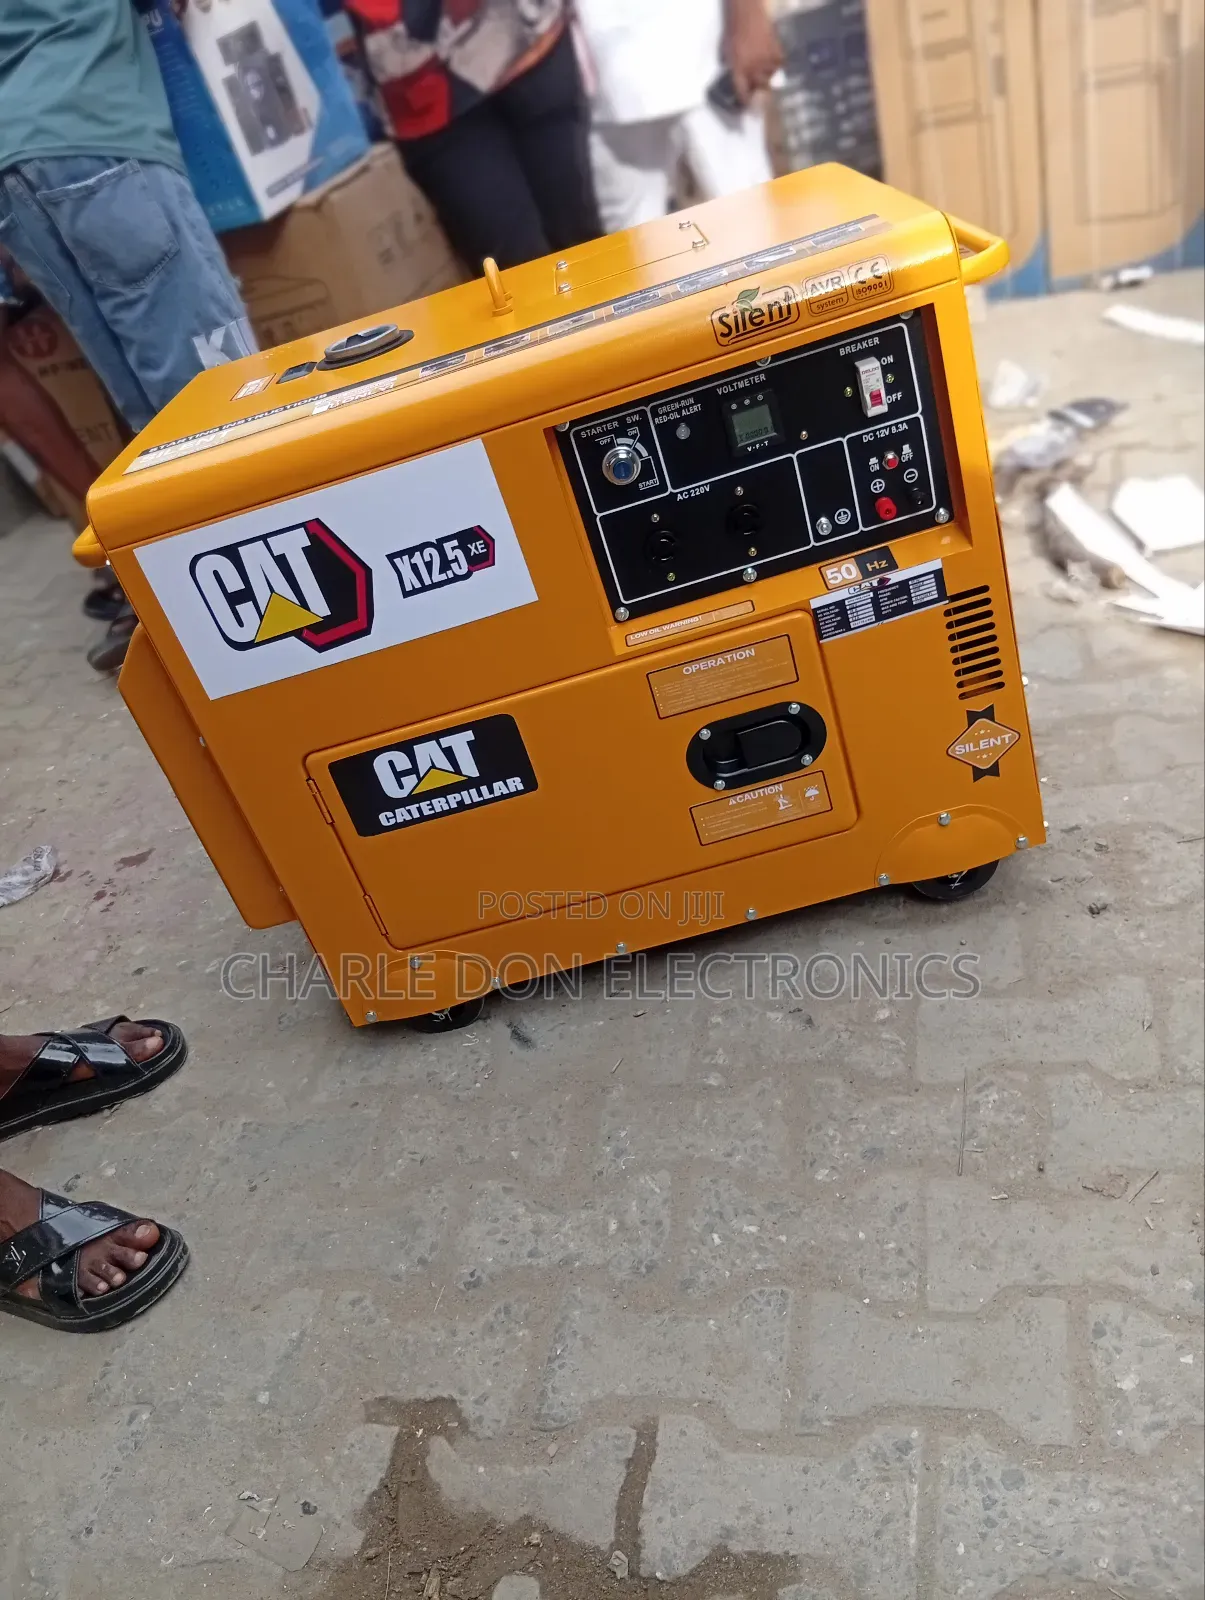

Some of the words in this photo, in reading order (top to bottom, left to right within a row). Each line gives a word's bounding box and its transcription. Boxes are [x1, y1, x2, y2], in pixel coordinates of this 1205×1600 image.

[809, 275, 843, 295] AVR
[718, 290, 792, 338] Silent
[816, 296, 844, 311] system
[839, 336, 880, 356] BREAKER
[881, 354, 894, 366] ON
[716, 373, 766, 396] VOLTMETER
[657, 397, 695, 415] GREEN-RUN
[886, 391, 903, 404] OFF
[148, 427, 219, 453] STARTING
[222, 393, 328, 430] INSTRUCTIONS
[654, 411, 681, 425] RED-OIL
[681, 403, 702, 417] ALERT
[580, 420, 620, 438] STARTER
[625, 414, 643, 425] SW.
[627, 429, 638, 437] ON
[862, 433, 875, 443] DC
[876, 427, 890, 439] 12V
[891, 422, 909, 434] 8.3A
[599, 437, 612, 446] OFF
[869, 463, 880, 473] ON
[901, 452, 914, 463] OFF
[638, 478, 658, 489] START
[676, 491, 690, 502] AC
[690, 484, 711, 497] 220V
[393, 539, 469, 592] X12.5
[467, 540, 488, 557] XE
[826, 563, 857, 585] 50
[866, 560, 889, 572] Hz
[192, 524, 333, 646] CAT
[630, 630, 648, 640] LOW
[649, 627, 662, 635] OIL
[662, 615, 703, 630] WARNING!
[682, 648, 755, 675] OPERATION
[955, 733, 1012, 755] SILENT
[373, 731, 481, 798] CAT
[378, 776, 524, 827] CATERPILLAR
[731, 783, 784, 804] CAUTION
